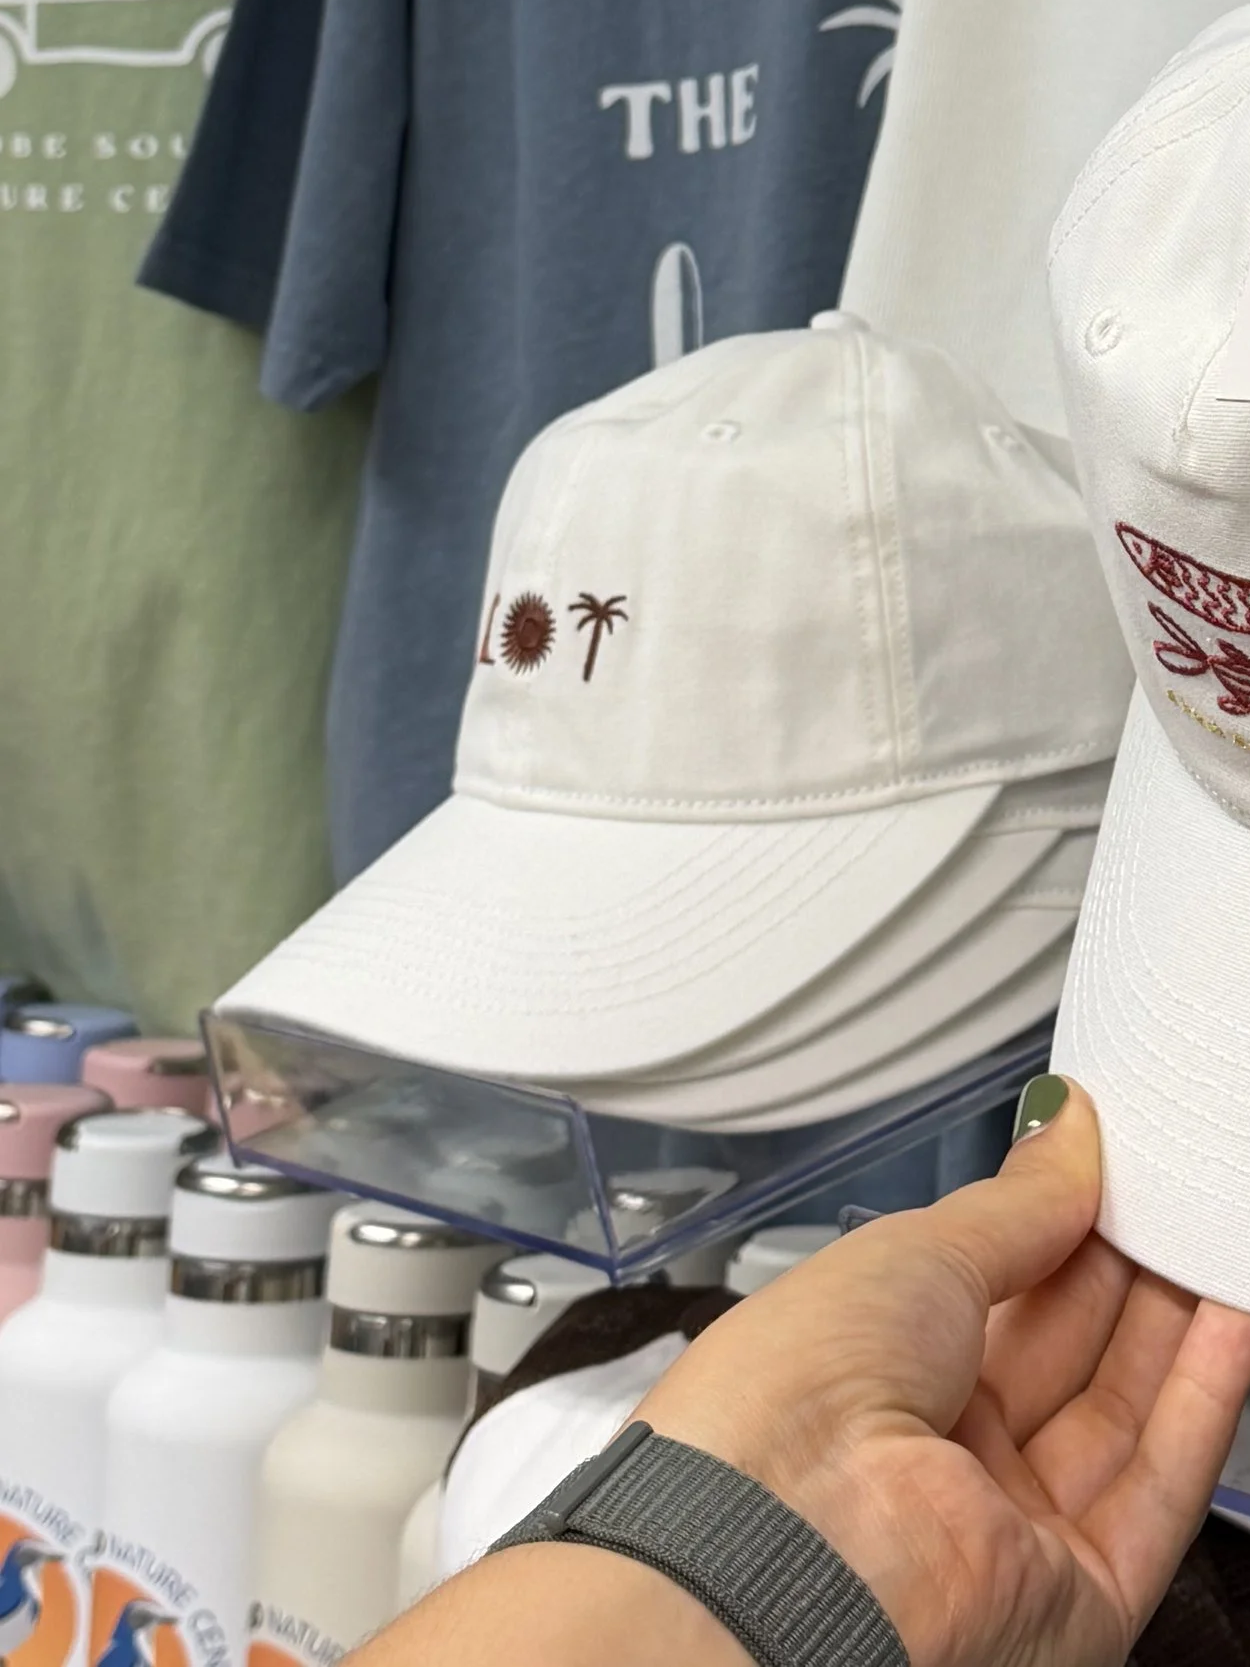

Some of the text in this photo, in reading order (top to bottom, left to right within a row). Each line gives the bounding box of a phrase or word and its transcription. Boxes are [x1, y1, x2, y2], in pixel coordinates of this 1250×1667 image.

[0, 132, 67, 160] BE
[599, 63, 760, 160] THE
[104, 1530, 199, 1608] NATURE
